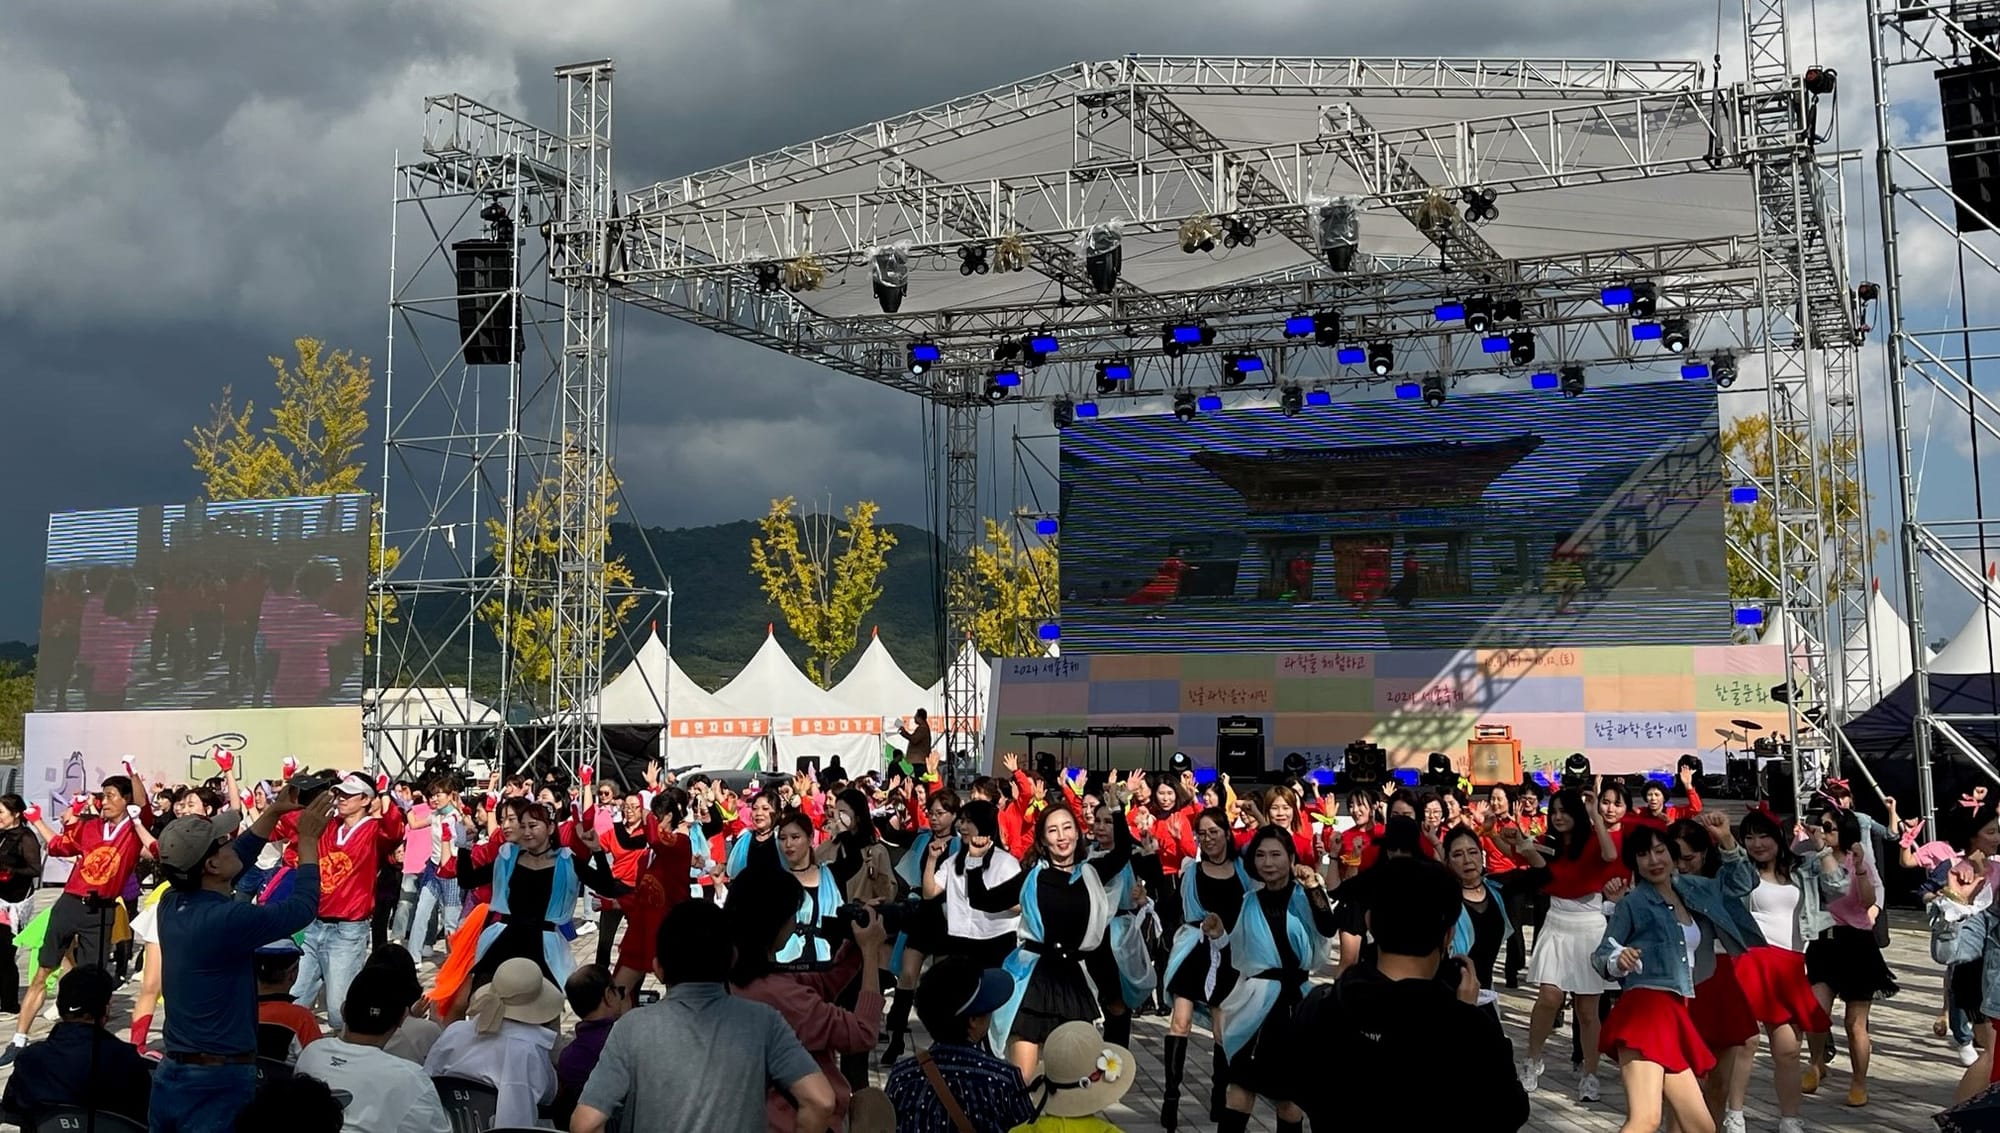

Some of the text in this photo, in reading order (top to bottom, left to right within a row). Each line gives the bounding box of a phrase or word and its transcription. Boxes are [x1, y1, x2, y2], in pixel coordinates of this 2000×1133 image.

[1014, 657, 1079, 677] 2024 세종축제
[1285, 653, 1365, 674] 과학을 체험하고
[1387, 691, 1415, 704] 2024
[453, 1089, 470, 1100] BJ
[60, 1117, 80, 1129] BJ
